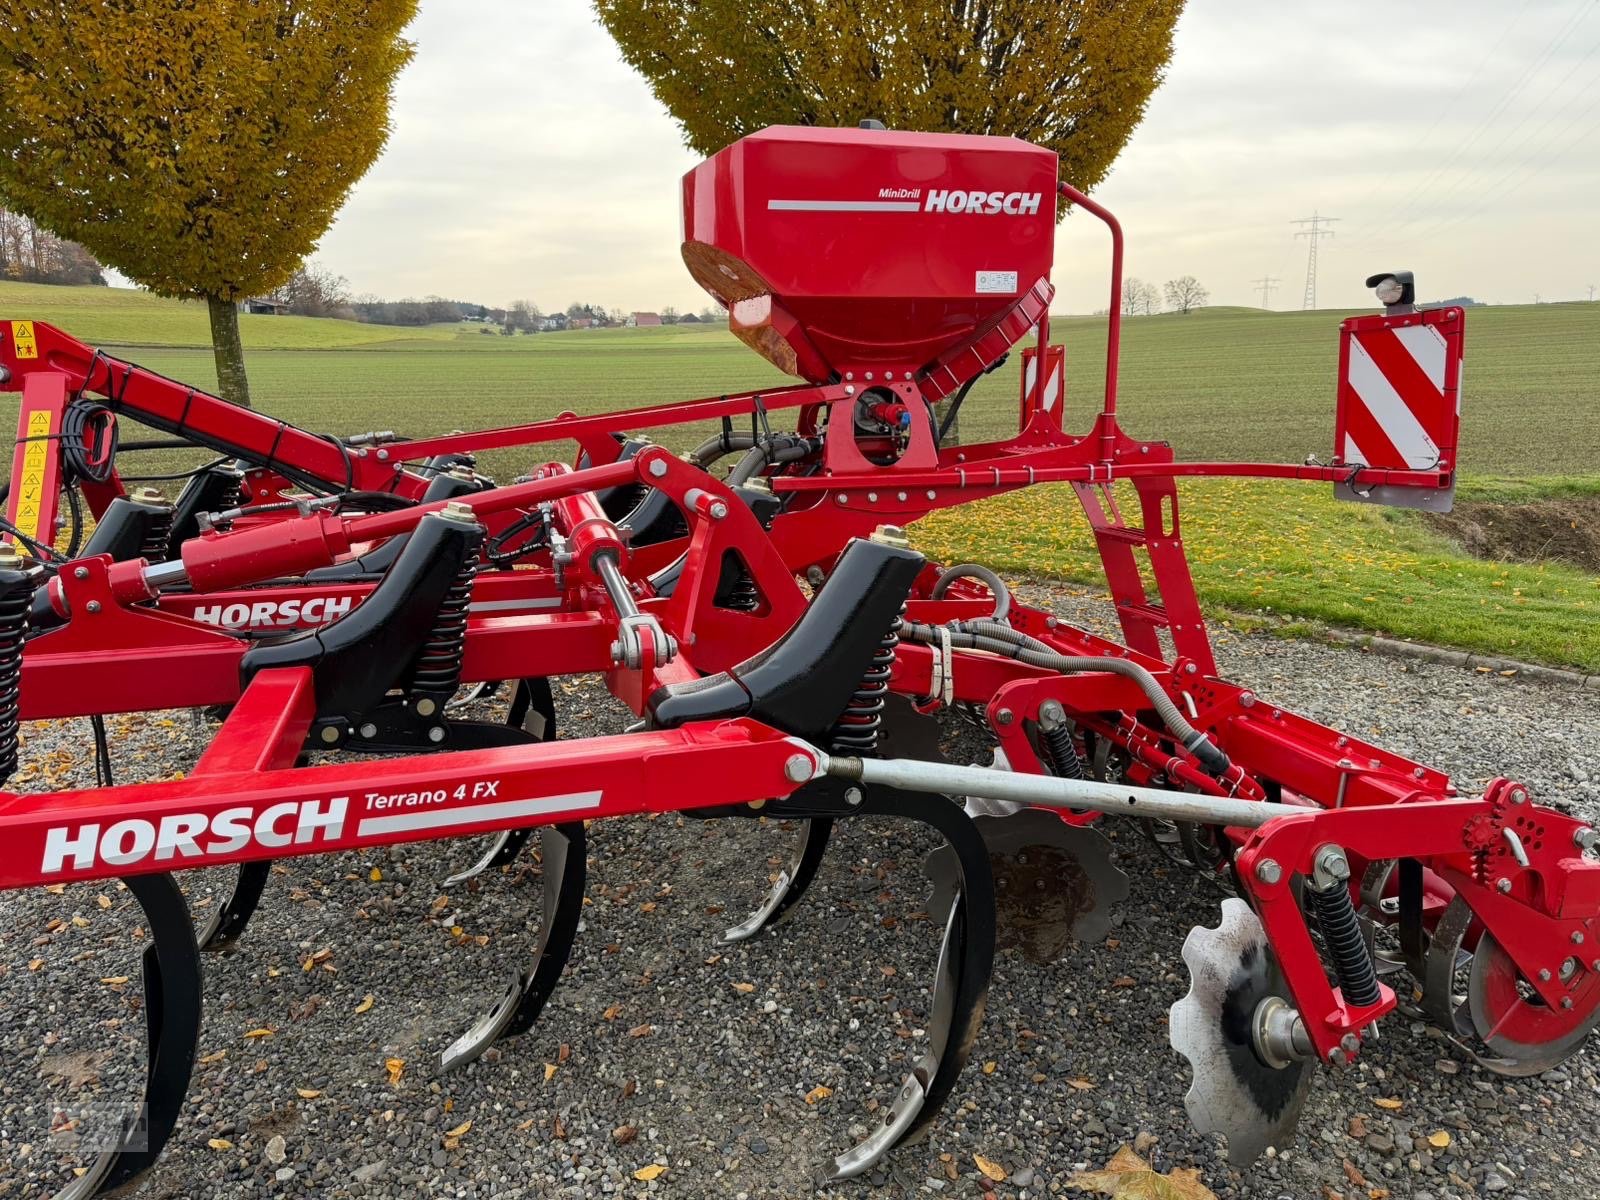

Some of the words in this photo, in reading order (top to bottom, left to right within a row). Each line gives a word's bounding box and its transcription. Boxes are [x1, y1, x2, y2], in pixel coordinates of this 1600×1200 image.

[878, 188, 921, 199] MiniDrill
[924, 189, 1042, 215] HORSCH
[193, 596, 352, 629] HORSCH
[364, 789, 447, 811] Terrano
[453, 783, 467, 800] 4
[472, 780, 500, 799] FX
[41, 796, 349, 874] HORSCH
